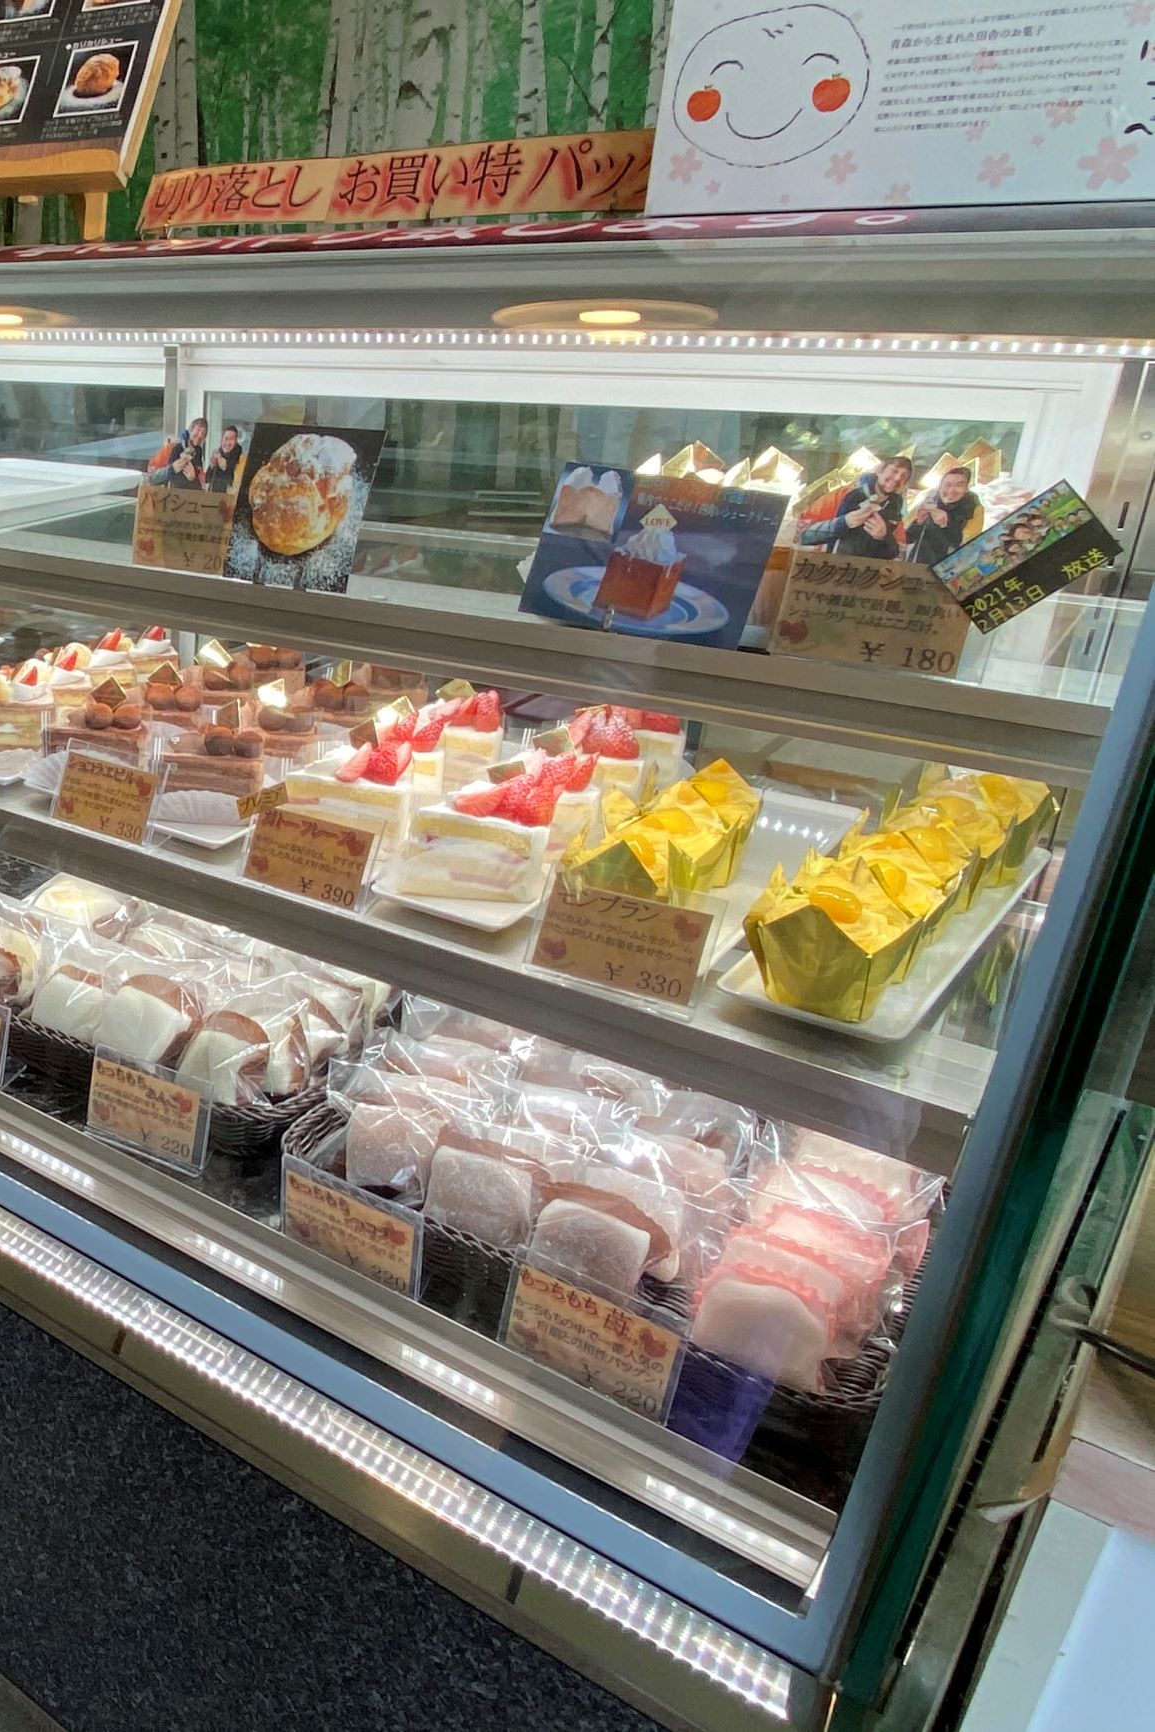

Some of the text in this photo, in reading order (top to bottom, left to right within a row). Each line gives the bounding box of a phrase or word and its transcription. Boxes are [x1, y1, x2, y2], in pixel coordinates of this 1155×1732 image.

[152, 164, 322, 212] 切り落とし
[139, 491, 219, 514] パイシュー
[203, 553, 223, 570] 20
[791, 557, 939, 593] カクカクシュー
[1062, 548, 1108, 580] 放送
[965, 576, 1025, 618] 2021年
[977, 584, 1046, 632] 2月13日
[860, 640, 956, 673] ¥ 180
[98, 815, 143, 841] ¥ 330
[298, 877, 355, 907] ¥ 390
[557, 888, 661, 923] モンブラン
[603, 961, 682, 998] ¥ 330
[160, 1135, 191, 1158] 220
[367, 1264, 406, 1294] 220
[520, 1267, 599, 1317] もっちもち
[581, 1362, 658, 1414] ¥ 220
